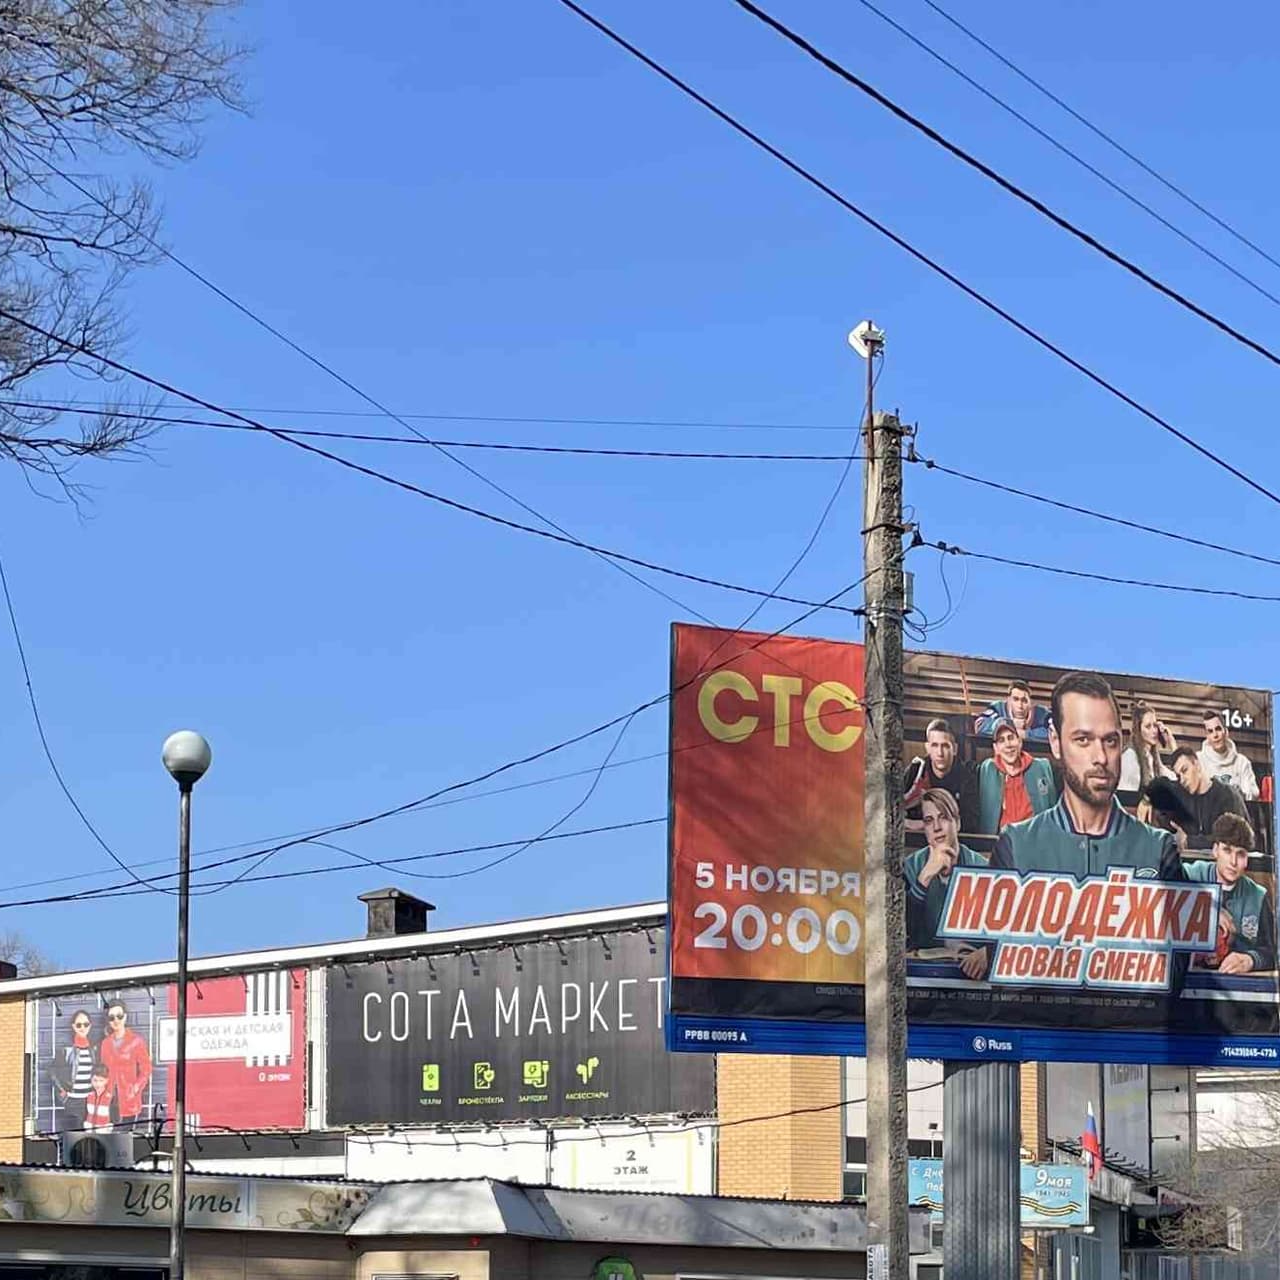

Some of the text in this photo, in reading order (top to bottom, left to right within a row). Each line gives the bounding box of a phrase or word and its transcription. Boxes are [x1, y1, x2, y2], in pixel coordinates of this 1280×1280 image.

[698, 670, 863, 752] СТС
[1222, 709, 1253, 728] 16+
[695, 862, 861, 897] 5 НОЯБРЯ
[947, 873, 1212, 943] МОЛОДЁЖКА
[694, 902, 861, 955] 20:00
[996, 945, 1166, 984] НОВАЯ СМЕНА
[363, 977, 667, 1042] СОТА МАРКЕТ
[200, 1037, 249, 1050] ОДЕЖДА
[988, 1040, 1012, 1050] Russ
[613, 1166, 648, 1175] ЭТАЖ
[626, 1150, 636, 1161] 2
[123, 1181, 242, 1217] Цвты
